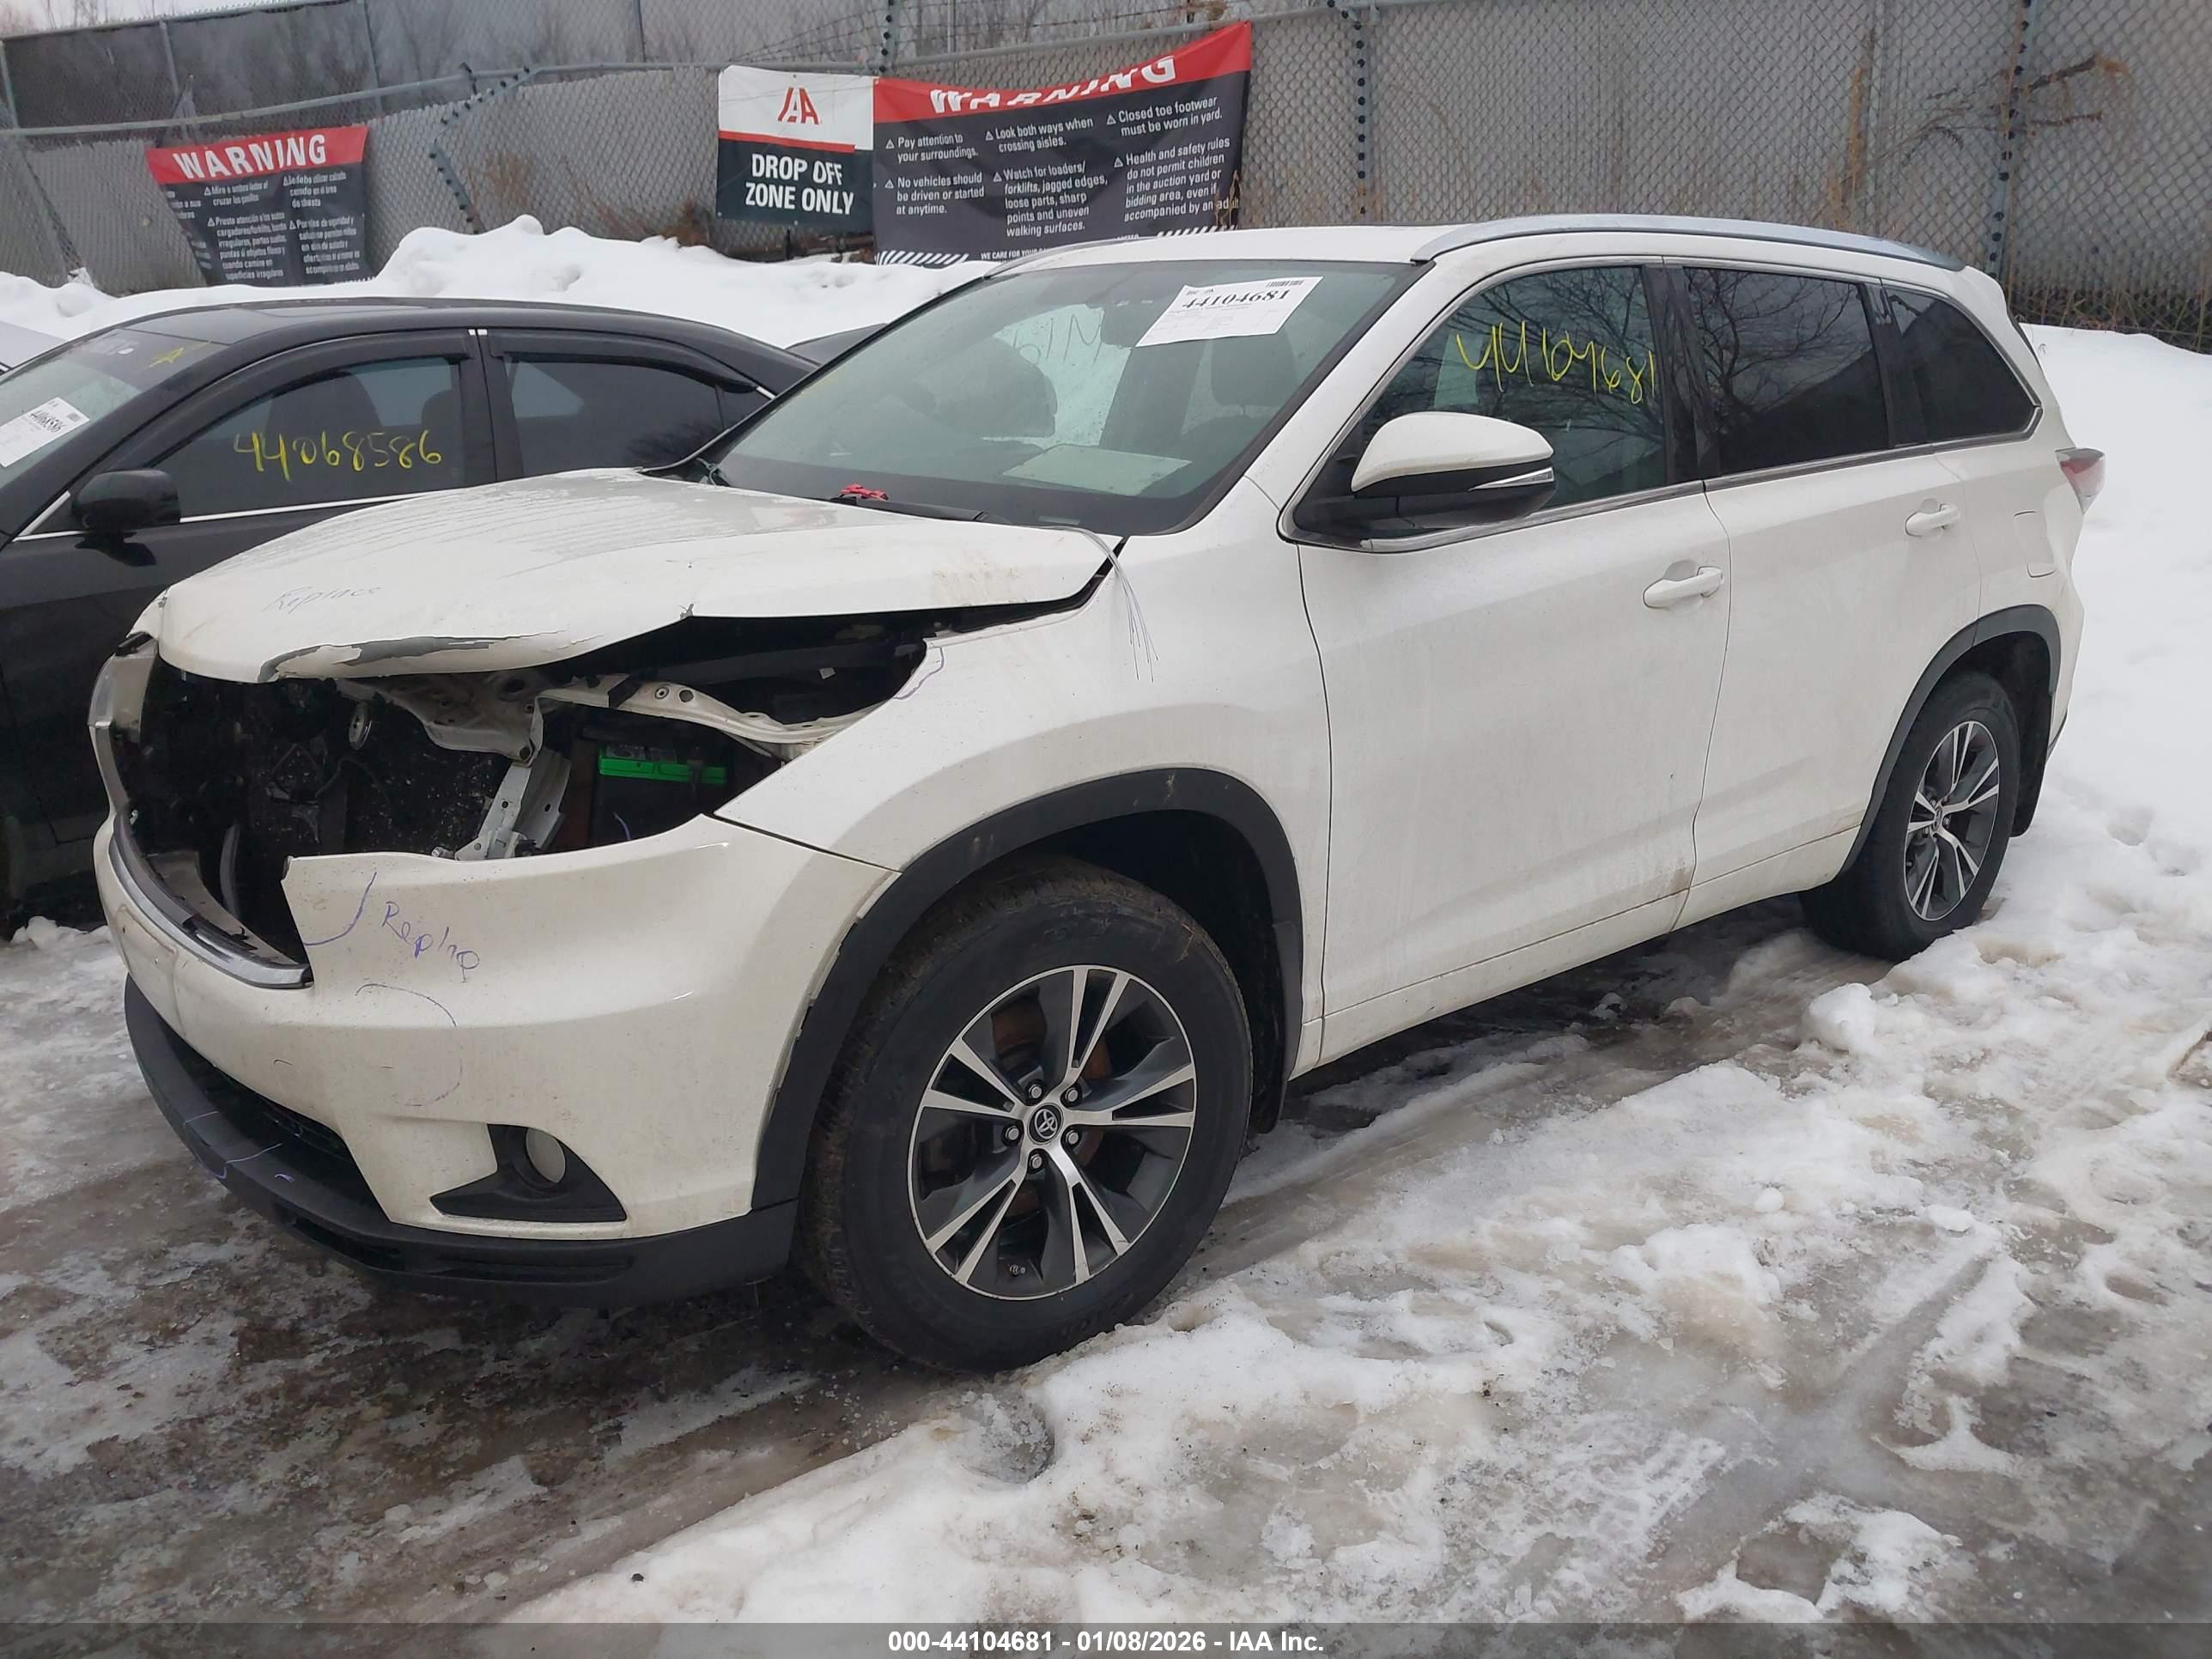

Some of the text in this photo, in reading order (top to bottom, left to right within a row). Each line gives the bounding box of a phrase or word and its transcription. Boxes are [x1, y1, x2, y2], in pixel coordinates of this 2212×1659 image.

[930, 55, 1176, 114] WARNING
[1119, 96, 1217, 122] Closed toe footwear
[995, 118, 1093, 139] Look both ways when
[1121, 106, 1222, 137] must be worn in yard.
[897, 133, 963, 149] Pay attention to
[999, 136, 1066, 153] crossing aisles.
[1126, 137, 1230, 166] Health and safety rules
[173, 134, 326, 179] WARNING
[897, 146, 978, 164] your surroundings.
[751, 154, 842, 185] DROP OFF
[1003, 160, 1085, 181] Watch for loaders/
[1127, 154, 1224, 180] do not permit children
[897, 172, 982, 187] No vehicles should
[1005, 174, 1108, 195] forklifts, jagged edges,
[1126, 169, 1221, 194] in the auction yard or
[745, 182, 854, 215] ZONE ONLY
[896, 185, 984, 202] be driven or started
[1005, 191, 1087, 210] loose parts, sharp
[1126, 182, 1217, 208] bidding area, even if
[896, 204, 947, 216] at anytime.
[1006, 206, 1089, 224] points and uneven
[1124, 203, 1186, 222] accompanied
[1188, 201, 1200, 215] by
[1202, 201, 1213, 211] an
[1006, 221, 1085, 237] walking surfaces.
[992, 251, 1007, 259] CARE
[1182, 289, 1291, 309] 44104681
[234, 429, 442, 482] 44068586
